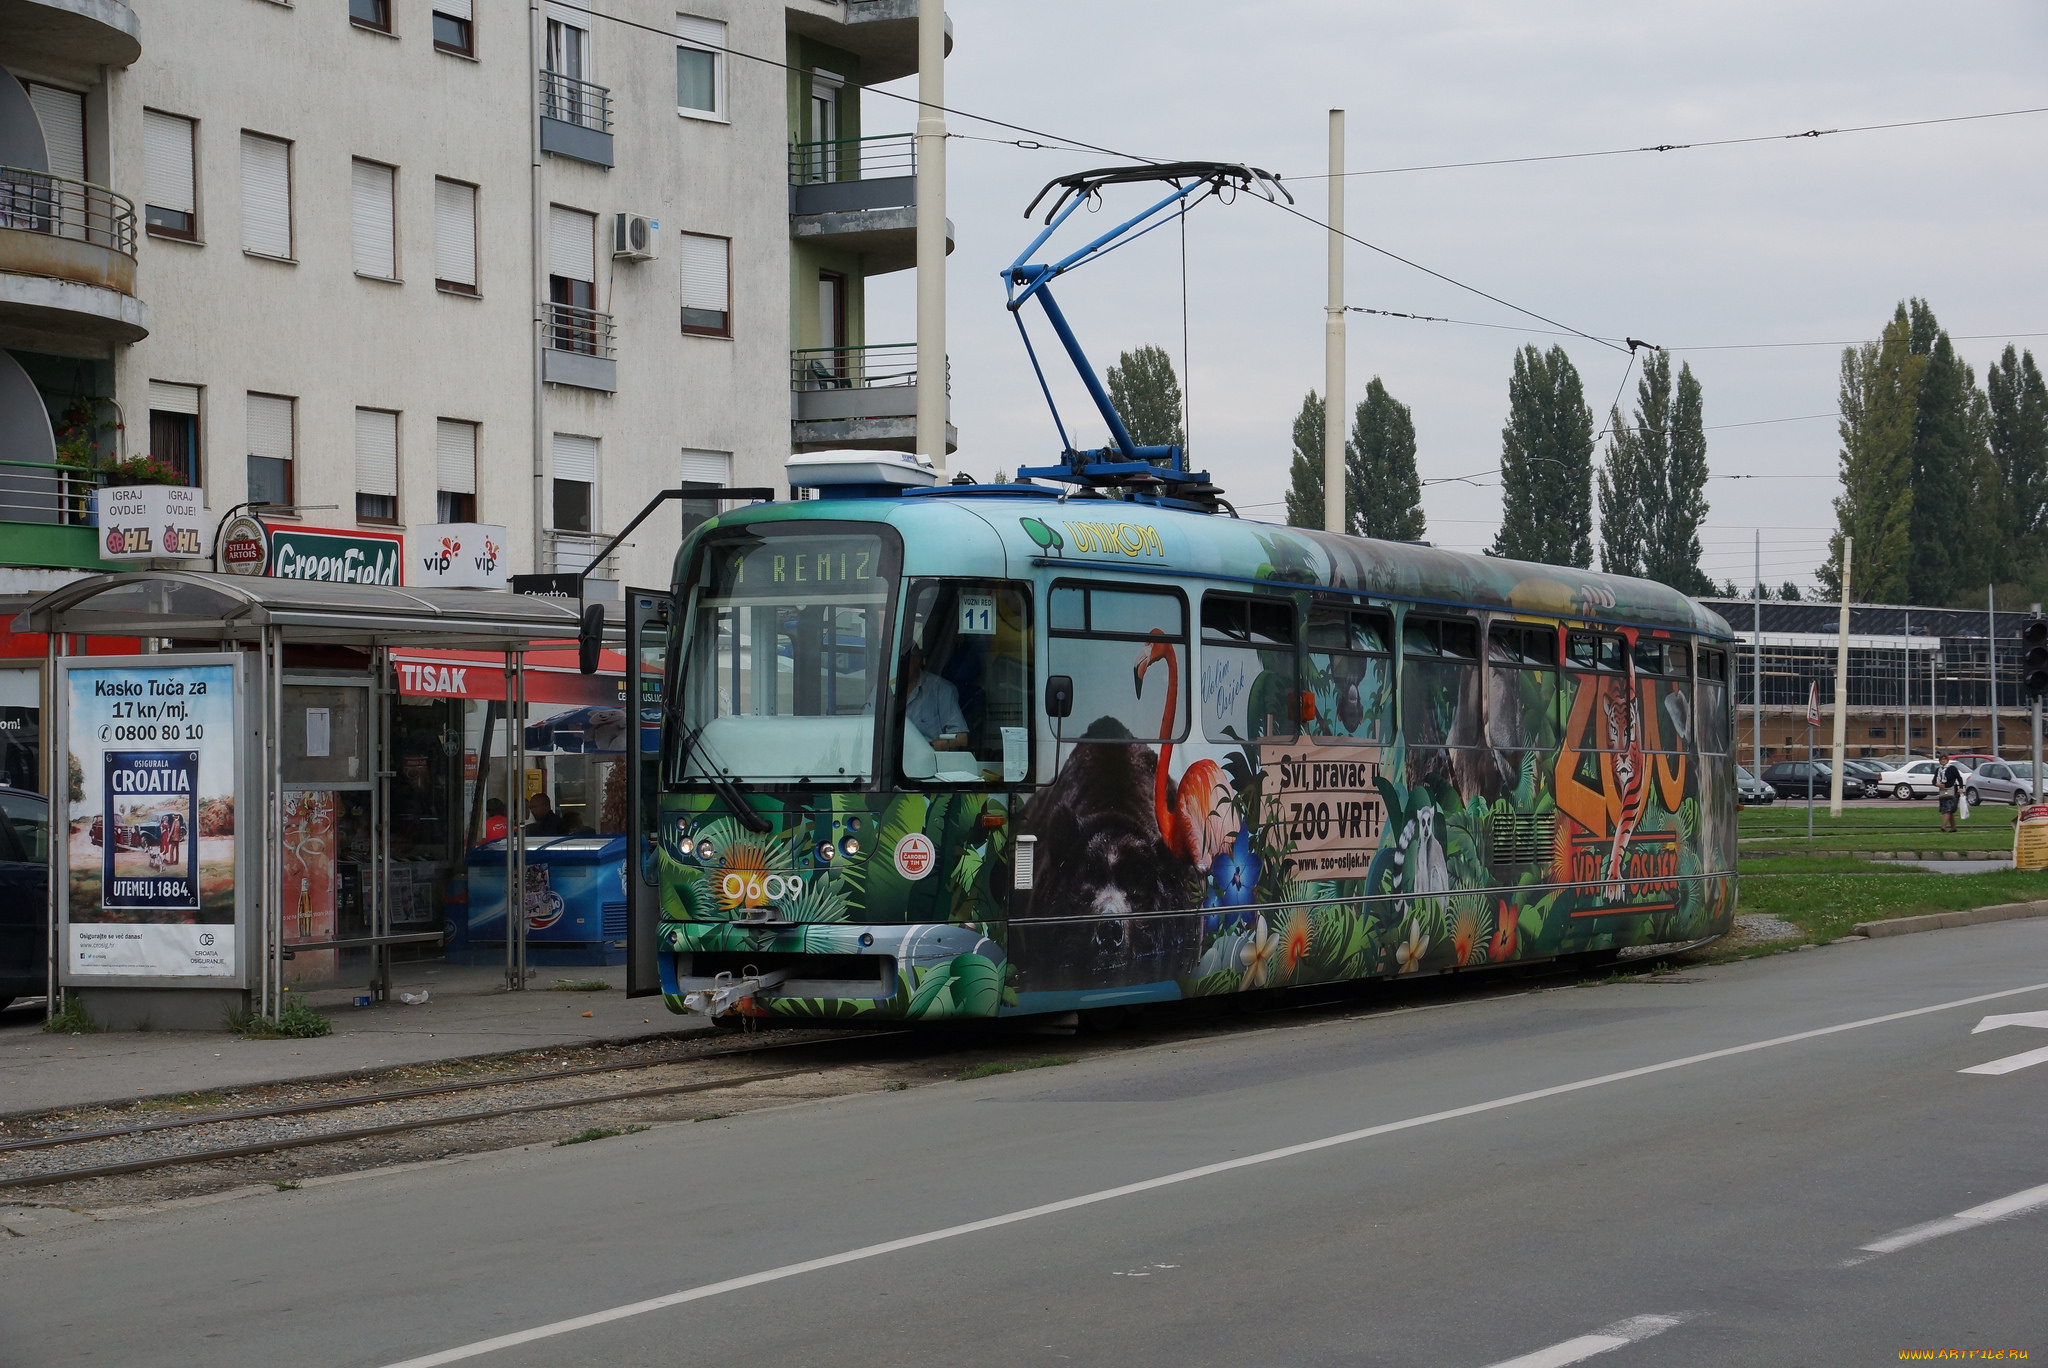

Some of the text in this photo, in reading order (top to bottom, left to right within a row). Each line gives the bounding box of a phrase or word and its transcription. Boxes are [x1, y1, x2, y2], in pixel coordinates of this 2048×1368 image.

[112, 489, 143, 501] IGRAJ
[168, 490, 193, 502] IGRAJ
[109, 504, 147, 516] OVDJE!
[166, 504, 196, 516] OVDJE!
[229, 543, 257, 552] STELLA
[1063, 520, 1164, 557] UNIKOM
[229, 550, 257, 559] ARTOIS
[423, 552, 451, 575] vip
[474, 552, 495, 575] vip
[773, 552, 870, 582] REMIZ
[965, 608, 989, 630] 11
[95, 678, 207, 697] Kasko Tuča za
[401, 665, 467, 693] TISAK
[112, 701, 189, 722] 17 kn/mj.
[115, 724, 204, 741] 0800 80 10
[134, 759, 169, 768] OSIGURALA
[1280, 754, 1310, 791] Svi,
[1313, 763, 1366, 789] pravac
[112, 769, 190, 792] CROATIA
[1290, 801, 1380, 840] ZOO VRT!
[1298, 858, 1318, 871] www.
[157, 881, 191, 897] 1884.
[723, 873, 803, 901] 0609
[79, 932, 107, 941] Osigurajte
